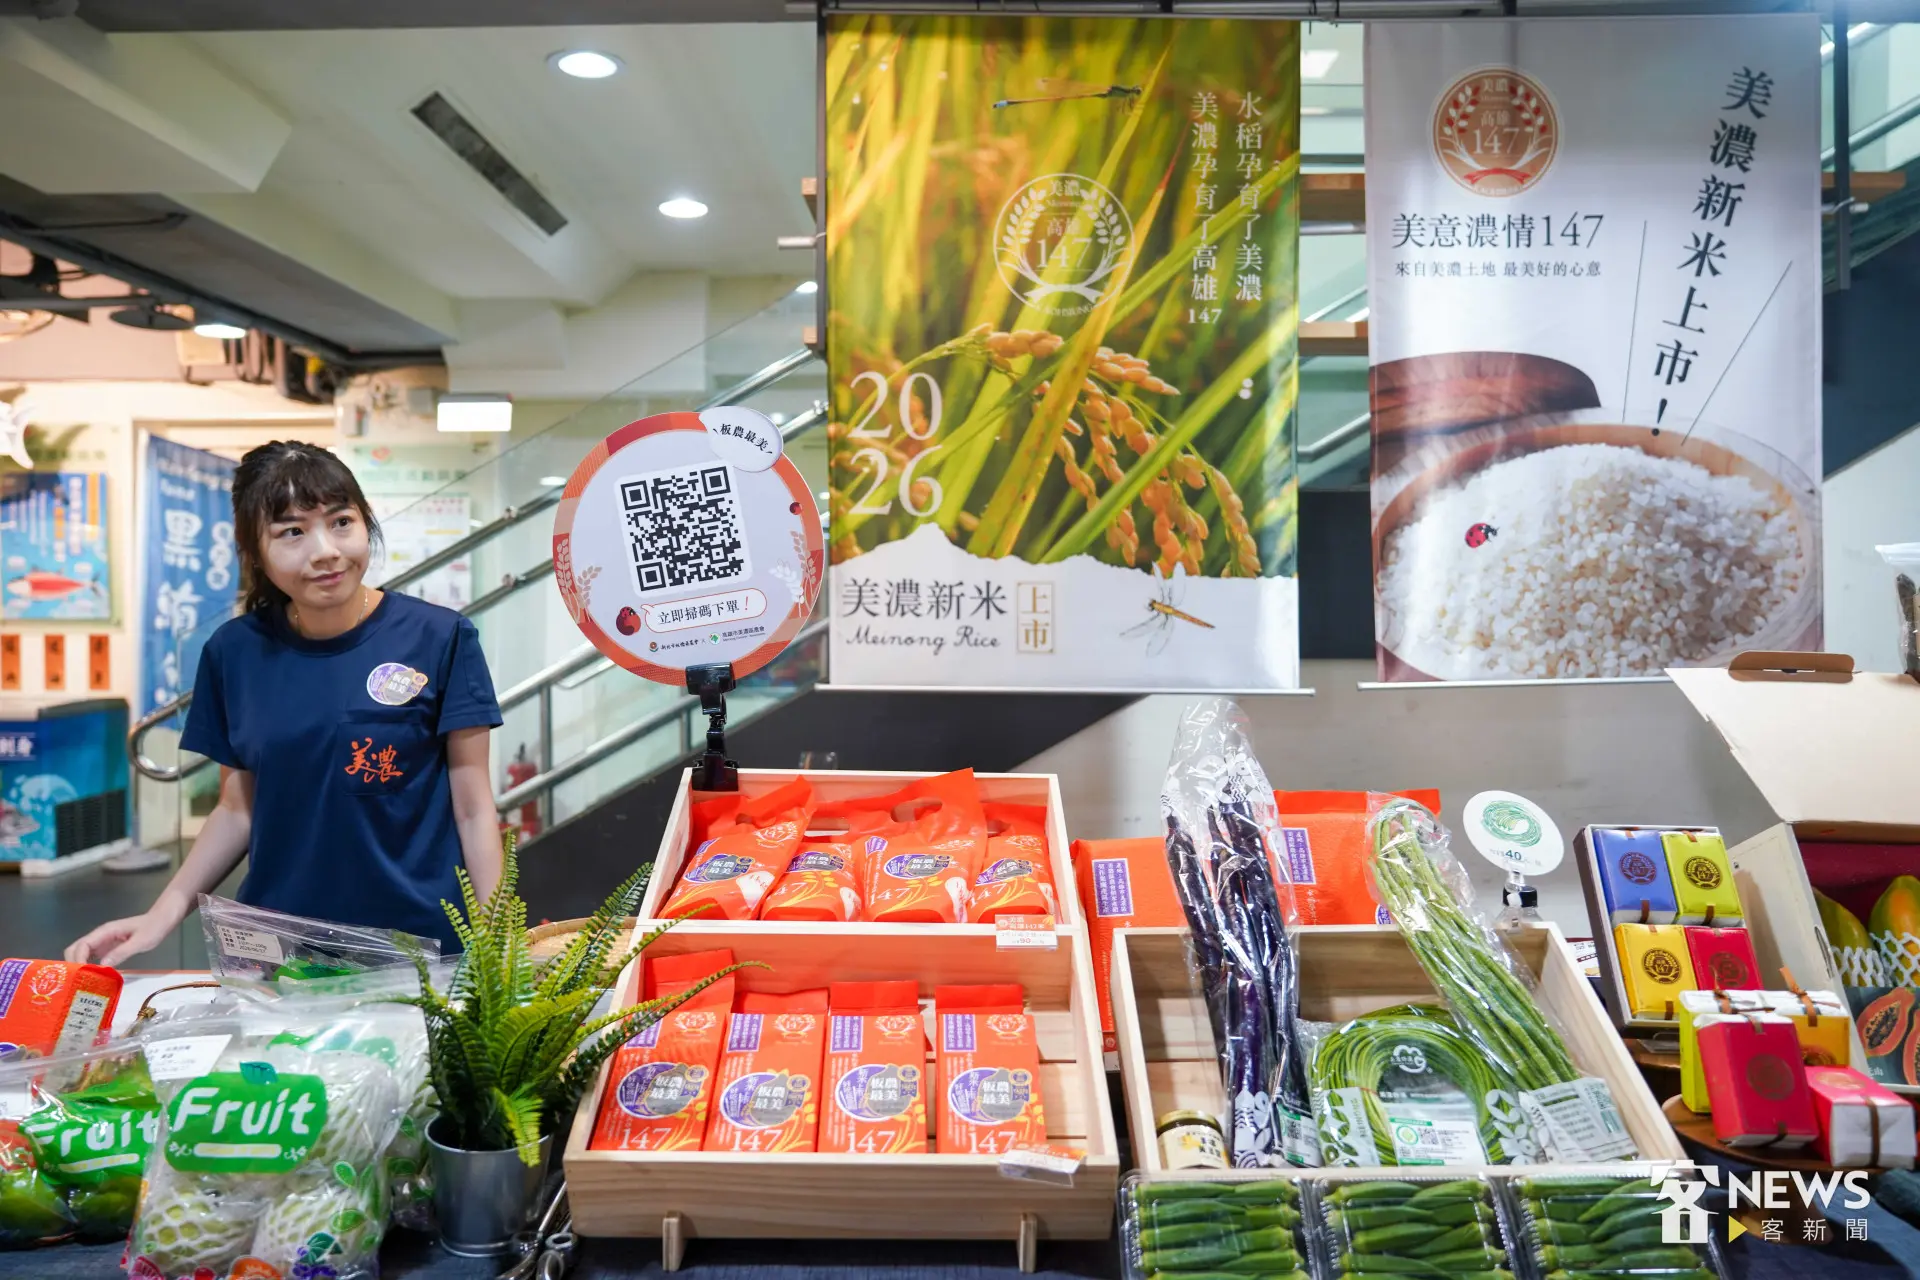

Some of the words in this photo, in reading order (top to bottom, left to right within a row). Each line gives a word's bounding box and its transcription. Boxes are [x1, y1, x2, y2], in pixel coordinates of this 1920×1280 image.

[1473, 126, 1519, 154] 147
[1191, 91, 1219, 301] 美濃孕育了高雄
[1235, 91, 1263, 302] 水稻孕育了美濃
[1392, 211, 1604, 249] 美意濃情147
[1036, 236, 1092, 268] 147
[1395, 261, 1496, 277] 來自美濃土地
[1503, 261, 1601, 277] 最美好的心意
[1188, 309, 1222, 324] 147
[848, 371, 943, 441] 20
[719, 423, 769, 452] 板農最美
[848, 445, 943, 517] 26
[841, 578, 1008, 620] 美濃新米
[1020, 584, 1051, 650] 上市
[847, 625, 946, 655] Meinong
[954, 625, 1002, 649] Rice
[1505, 850, 1522, 860] 40
[173, 1087, 316, 1136] Fruit
[24, 1110, 160, 1157] Fruit
[618, 1127, 672, 1149] 147
[730, 1129, 784, 1152] 147
[847, 1129, 896, 1153] 147
[968, 1130, 1017, 1154] 147
